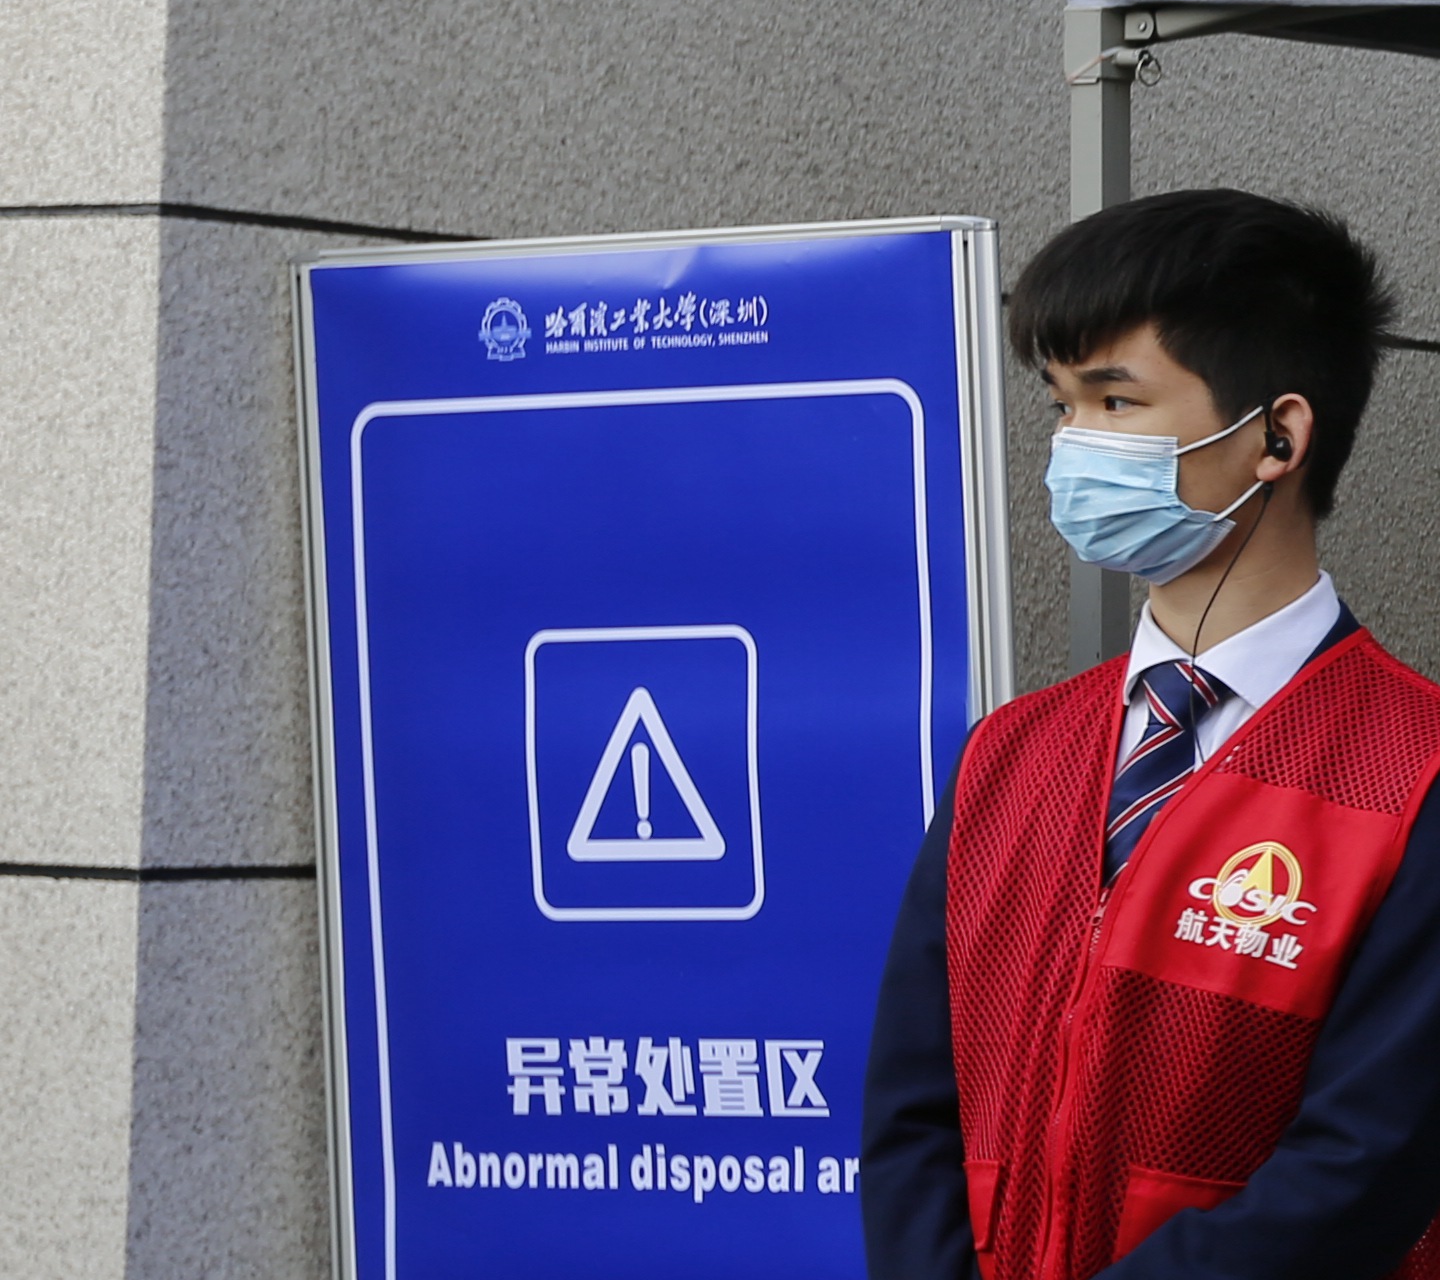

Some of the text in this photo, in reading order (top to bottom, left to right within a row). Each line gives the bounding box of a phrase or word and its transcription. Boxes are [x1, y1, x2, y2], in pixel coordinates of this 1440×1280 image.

[546, 330, 769, 355] HARBIN INSTITUTE OF TECHNOLOGY, SHENZHEN
[1174, 907, 1304, 970] 航天物业
[505, 1035, 831, 1118] 异常处置区
[426, 1140, 860, 1203] Abnormal disposal ar
